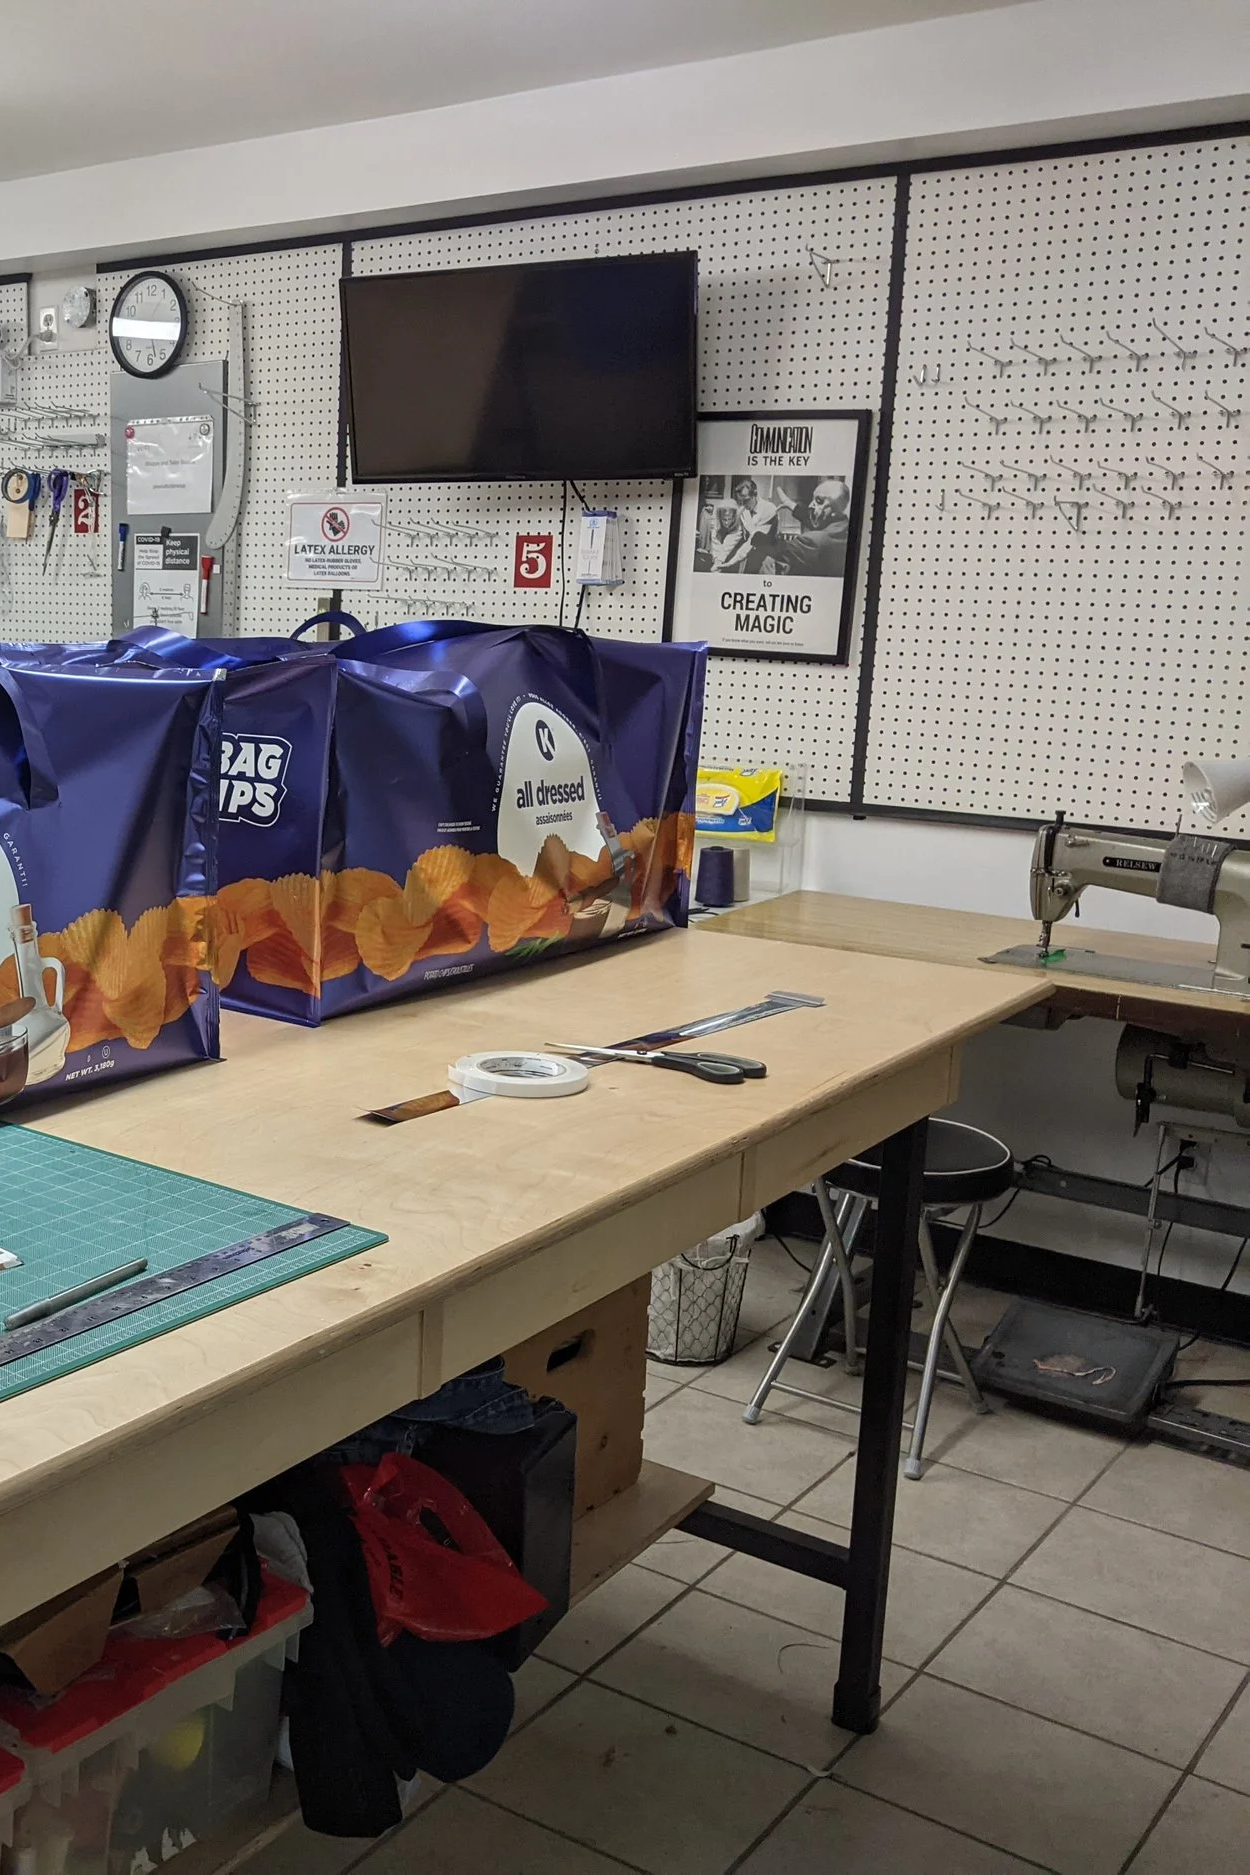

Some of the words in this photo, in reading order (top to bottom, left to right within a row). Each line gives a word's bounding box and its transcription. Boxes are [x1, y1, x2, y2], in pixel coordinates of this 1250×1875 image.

[146, 284, 157, 296] 12
[135, 292, 143, 304] 11
[126, 305, 136, 317] 10
[170, 300, 177, 312] 2
[135, 350, 142, 362] 7
[159, 348, 166, 360] 5
[747, 456, 758, 466] IS
[763, 456, 784, 466] THE
[788, 456, 810, 466] KEY
[165, 548, 189, 556] physical
[294, 544, 326, 555] LATEX
[329, 545, 375, 555] ALLERGY
[520, 542, 546, 579] 5
[762, 580, 773, 588] to
[721, 591, 812, 614] CREATING
[734, 613, 794, 634] MAGIC
[516, 780, 534, 809] all
[536, 775, 585, 806] dressed
[535, 810, 573, 826] assaisonnées
[65, 1070, 80, 1081] NET
[81, 1066, 93, 1076] WT.
[94, 1060, 115, 1072] 3,180g
